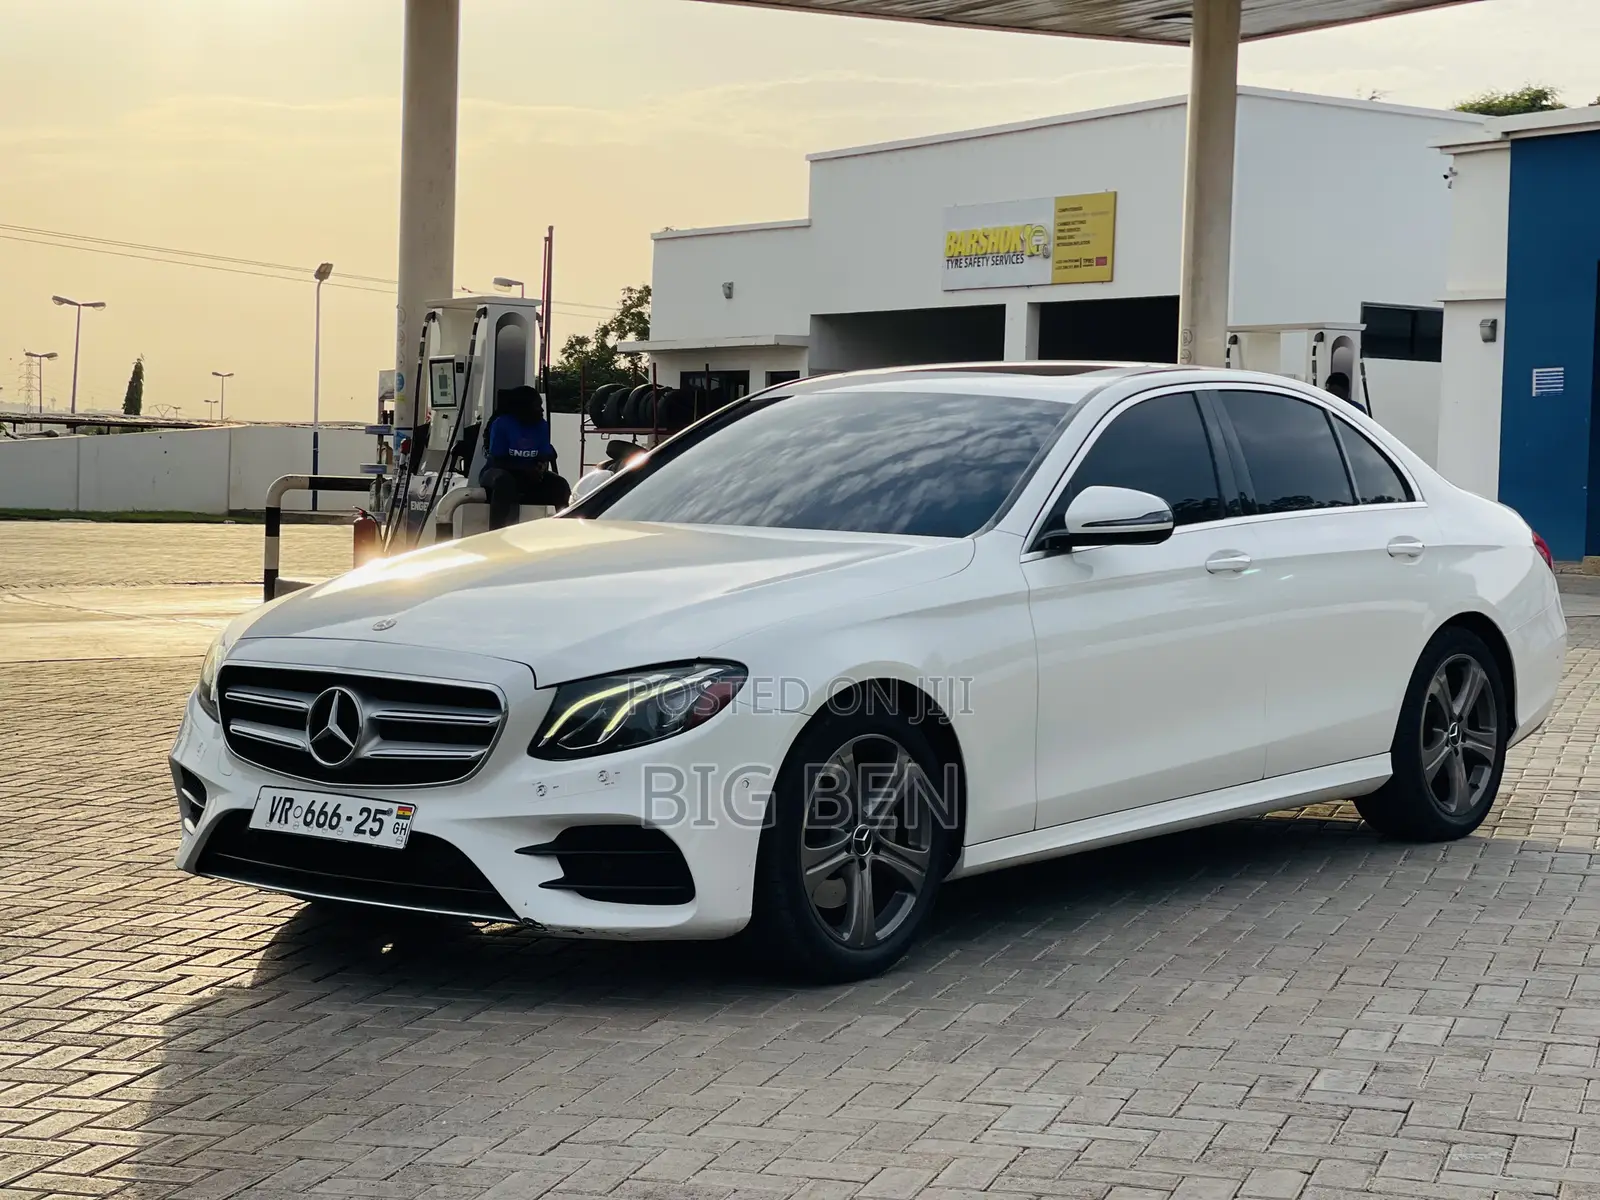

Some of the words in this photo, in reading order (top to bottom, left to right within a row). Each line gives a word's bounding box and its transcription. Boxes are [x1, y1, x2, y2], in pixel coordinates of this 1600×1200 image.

[946, 259, 963, 270] TYRE
[964, 256, 990, 269] SAFETY
[991, 253, 1025, 266] SERVICES
[410, 501, 430, 511] ENGE
[269, 796, 294, 825] VR
[303, 800, 390, 837] 666-25
[393, 822, 408, 836] GH
